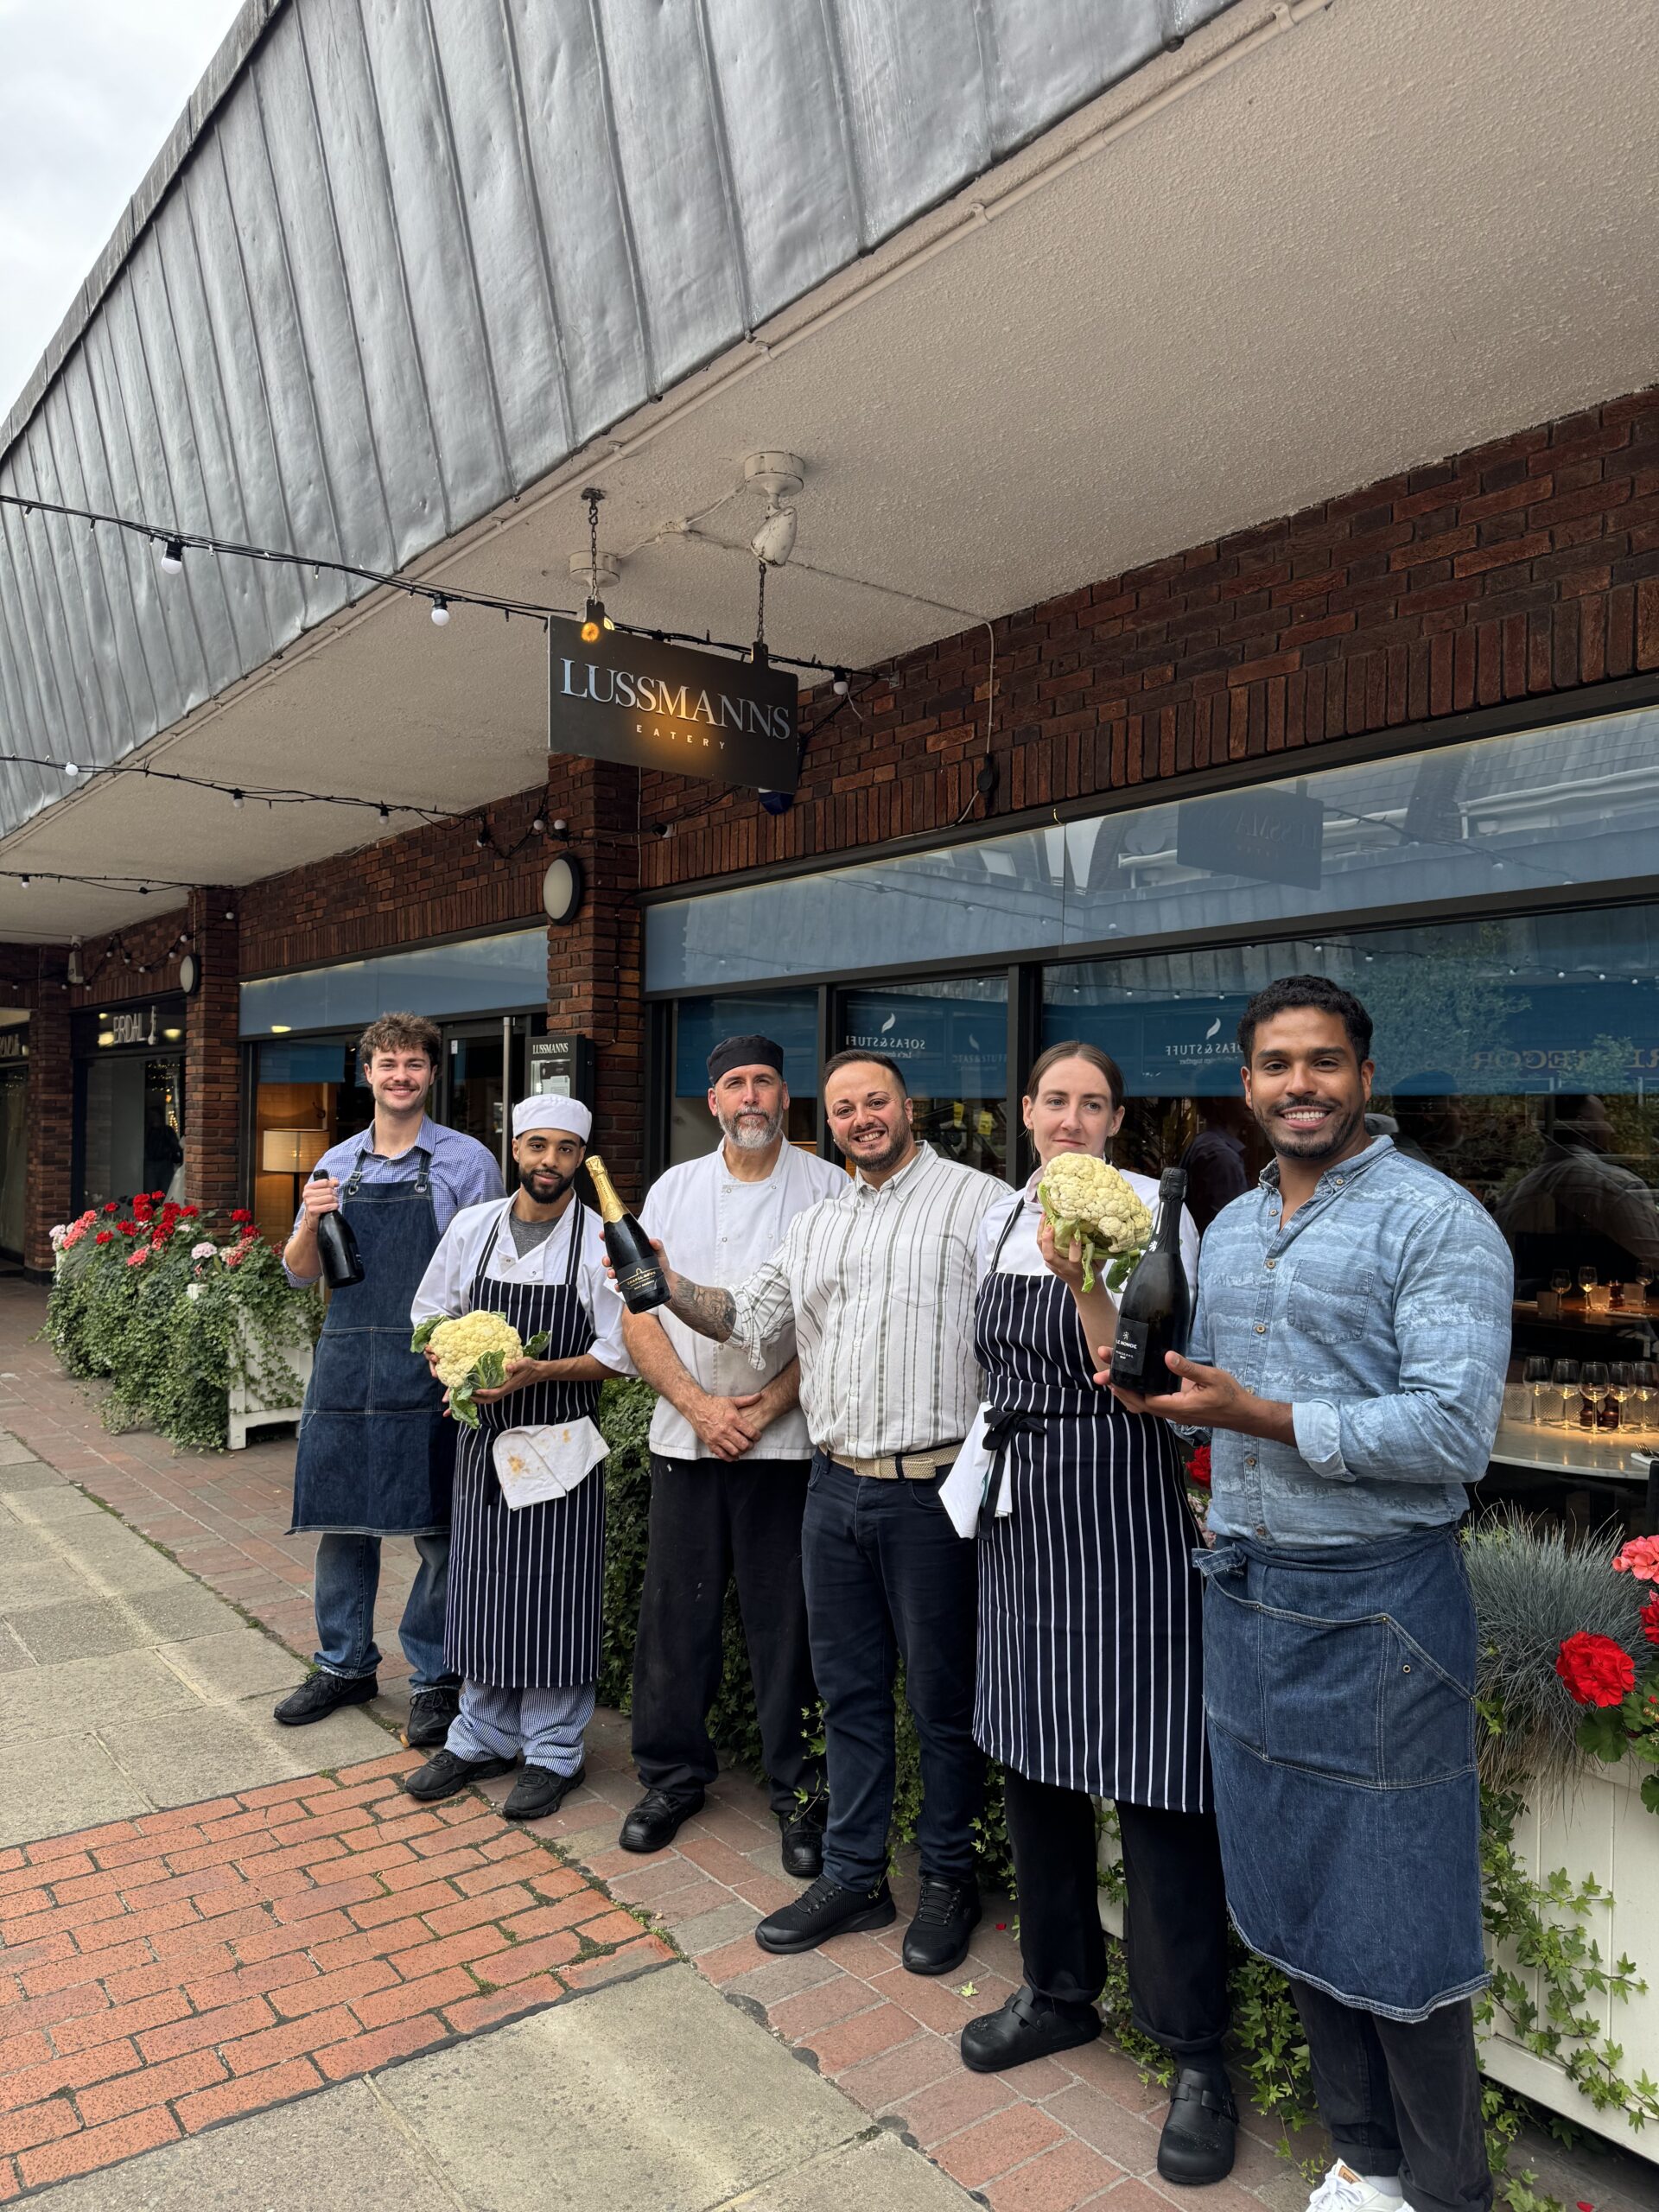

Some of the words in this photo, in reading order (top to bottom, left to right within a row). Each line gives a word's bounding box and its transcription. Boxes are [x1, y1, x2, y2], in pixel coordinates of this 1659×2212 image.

[560, 658, 791, 740] LUSSMANNS
[636, 724, 726, 750] EATERY
[112, 1013, 149, 1045] BRIDAL
[532, 1043, 569, 1054] LUSSMANNS
